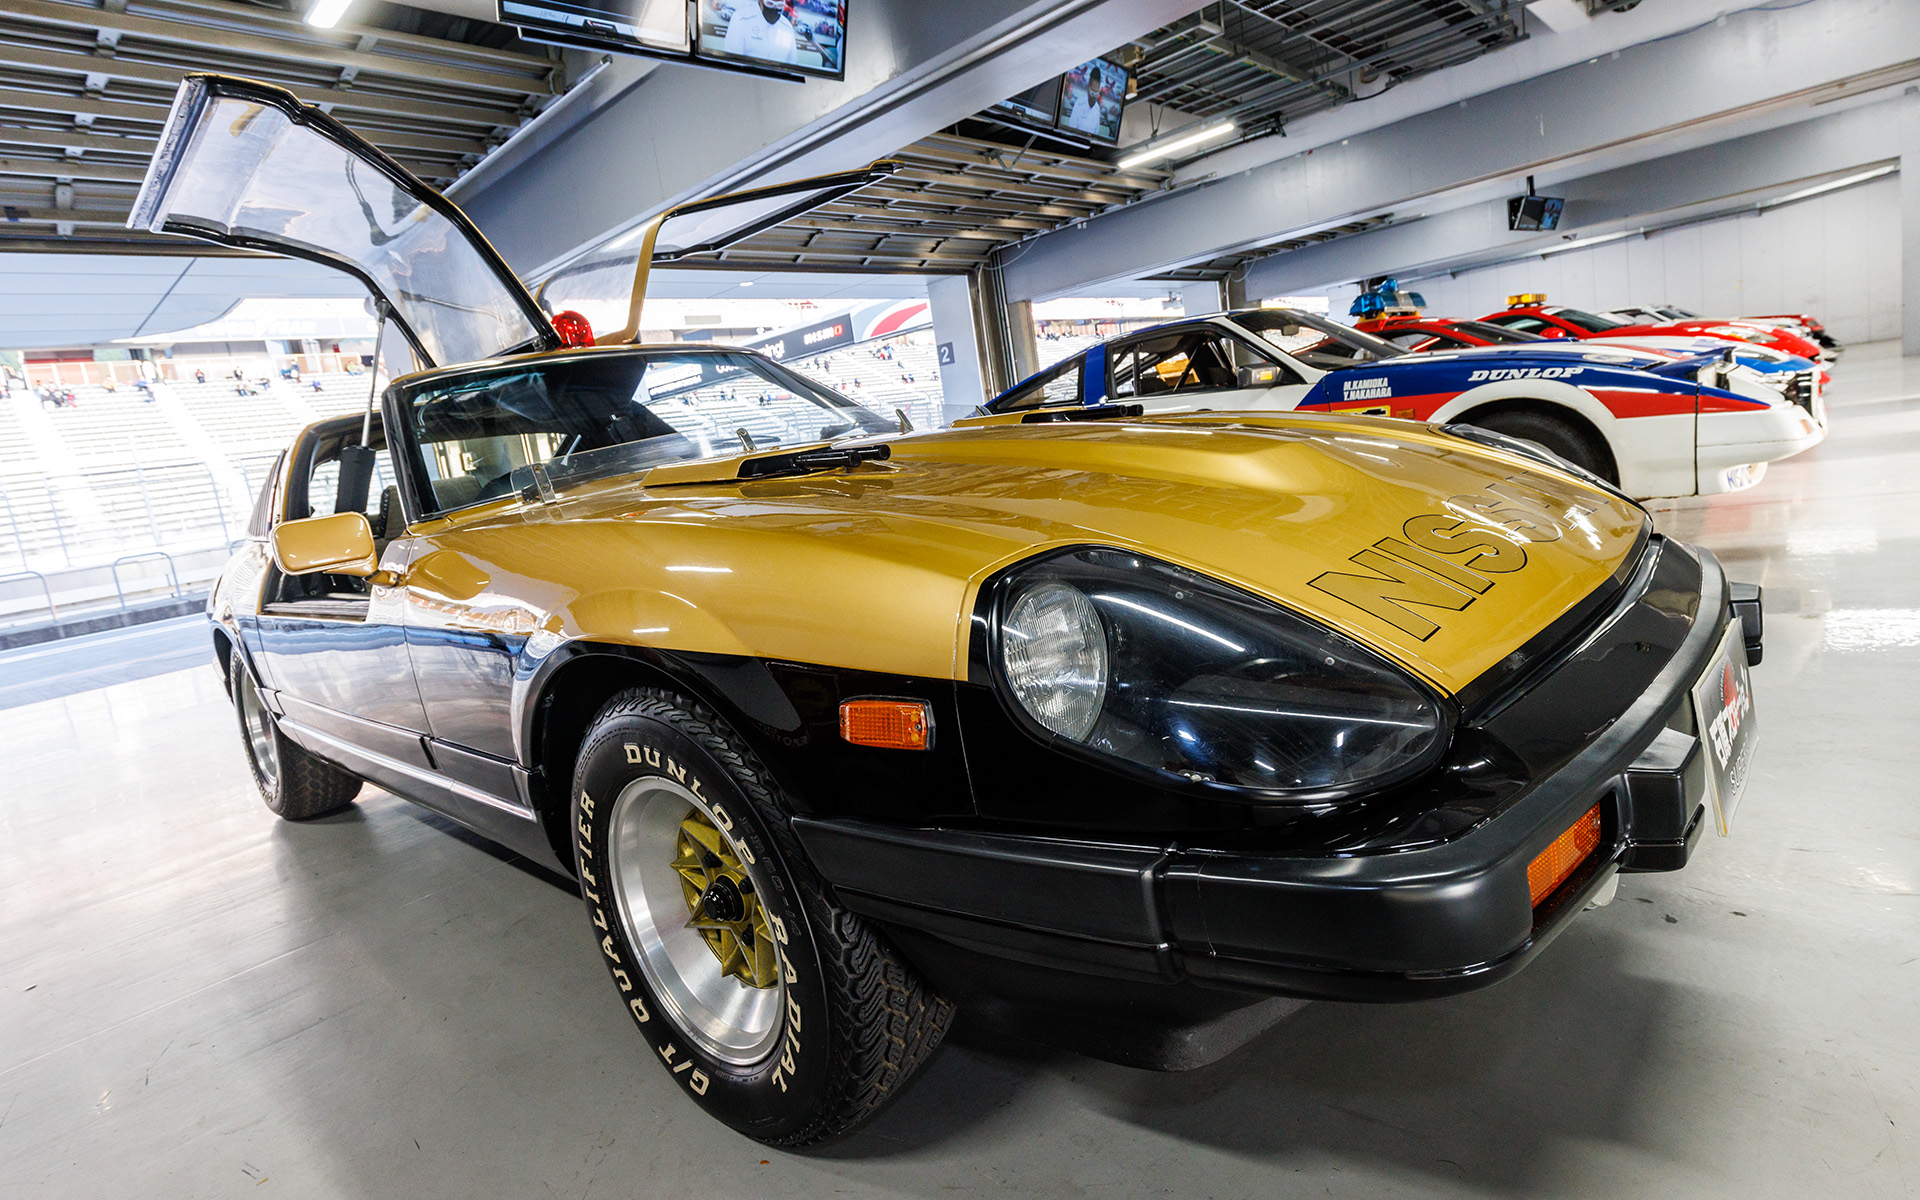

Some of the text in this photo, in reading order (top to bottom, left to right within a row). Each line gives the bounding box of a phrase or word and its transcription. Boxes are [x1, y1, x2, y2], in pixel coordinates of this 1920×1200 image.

[940, 345, 951, 363] 2
[1343, 377, 1389, 392] M.KAMIOKA
[1467, 367, 1585, 382] DUNLOP
[1343, 386, 1392, 401] Y.NAKAHARA
[623, 743, 756, 865] DUNLOP
[578, 788, 650, 1023] QUALIFIER
[768, 909, 802, 1094] RADIAL
[658, 1043, 710, 1096] G/T
